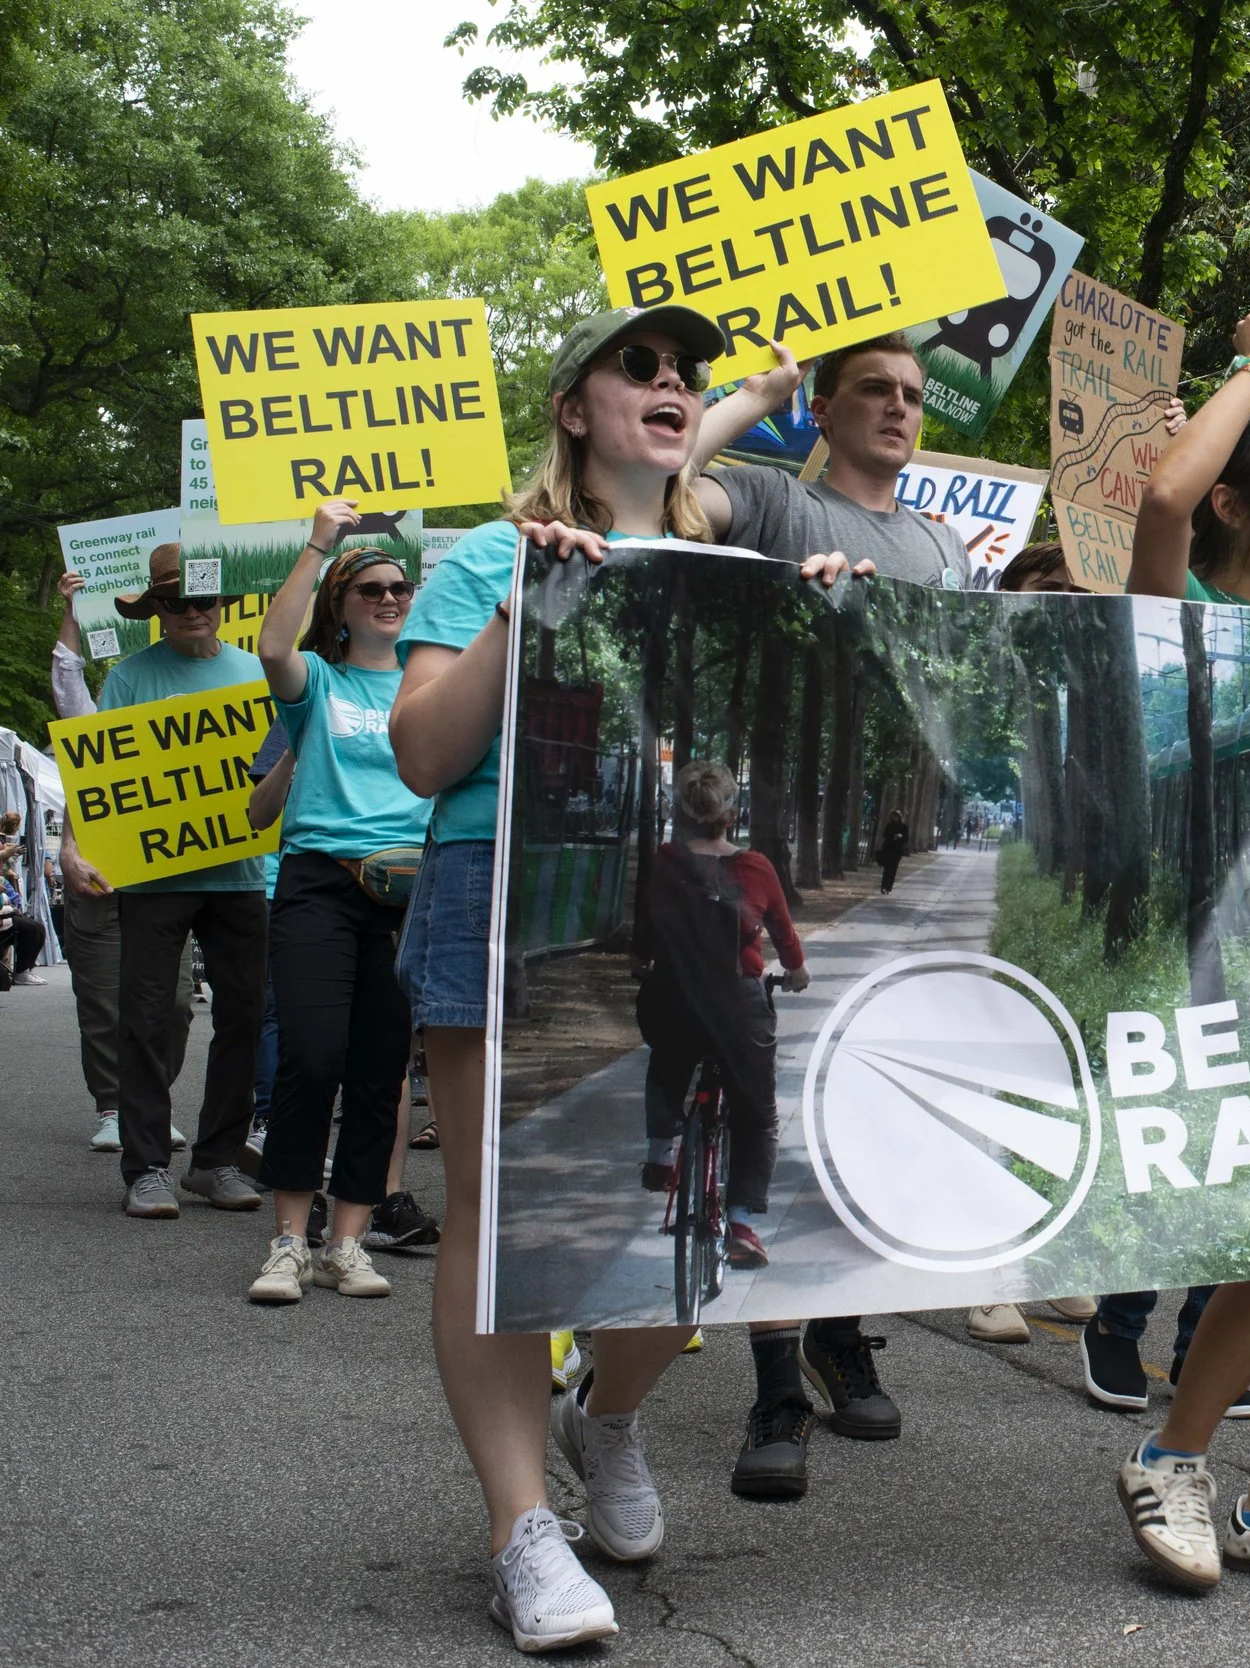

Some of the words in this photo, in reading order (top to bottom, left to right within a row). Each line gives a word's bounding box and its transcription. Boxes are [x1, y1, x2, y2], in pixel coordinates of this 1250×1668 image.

[606, 173, 720, 242] WE
[732, 105, 931, 201] WANT
[625, 171, 959, 308] BELTLINE
[716, 263, 902, 358] RAIL!
[1060, 274, 1171, 352] CHARLOTTE
[206, 330, 300, 375] WE
[312, 318, 472, 366] WANT
[1063, 319, 1086, 346] got
[1090, 327, 1115, 355] the
[1123, 340, 1169, 388] RAIL
[925, 377, 981, 415] BELTLINE
[1056, 350, 1118, 403] TRAIL
[219, 380, 485, 440] BELTLINE
[189, 458, 206, 471] to
[290, 448, 435, 499] RAIL!
[1131, 438, 1163, 473] WH
[189, 477, 208, 490] 45
[940, 474, 1018, 525] RAIL
[69, 532, 133, 550] Greenway
[136, 527, 156, 540] rail
[72, 555, 86, 566] to
[89, 545, 141, 563] connect
[431, 536, 460, 544] BELTLI
[1077, 541, 1128, 586] RAIL
[95, 561, 140, 577] Atlanta
[61, 724, 141, 769] WE
[148, 695, 277, 751] WANT
